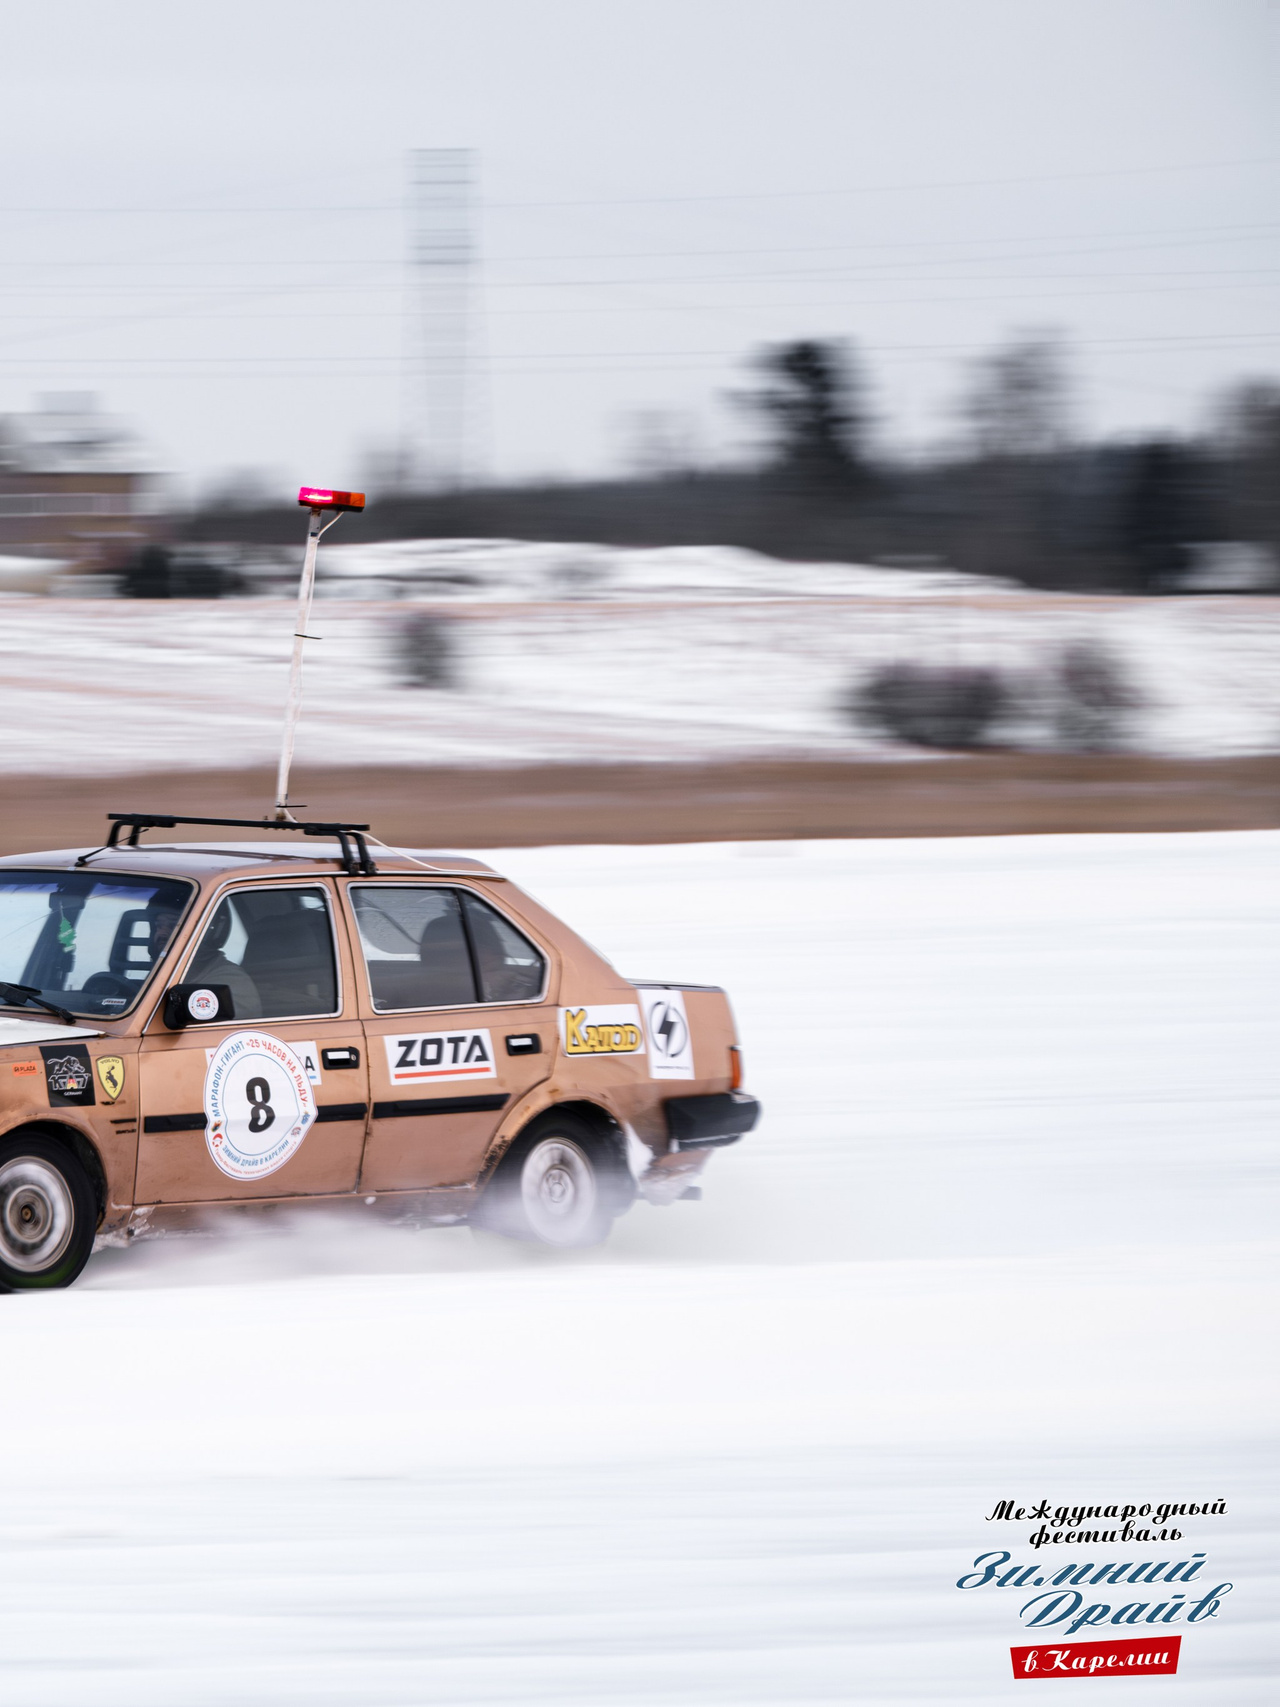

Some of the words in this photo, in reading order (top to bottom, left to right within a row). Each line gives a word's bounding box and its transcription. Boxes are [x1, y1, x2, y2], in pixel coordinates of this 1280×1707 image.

[210, 1041, 245, 1117] МАРАФОН-ГИГАНТ
[261, 1040, 287, 1061] ЧАСОВ
[286, 1059, 296, 1074] НА
[394, 1035, 490, 1068] ZOTA
[245, 1076, 276, 1133] 8
